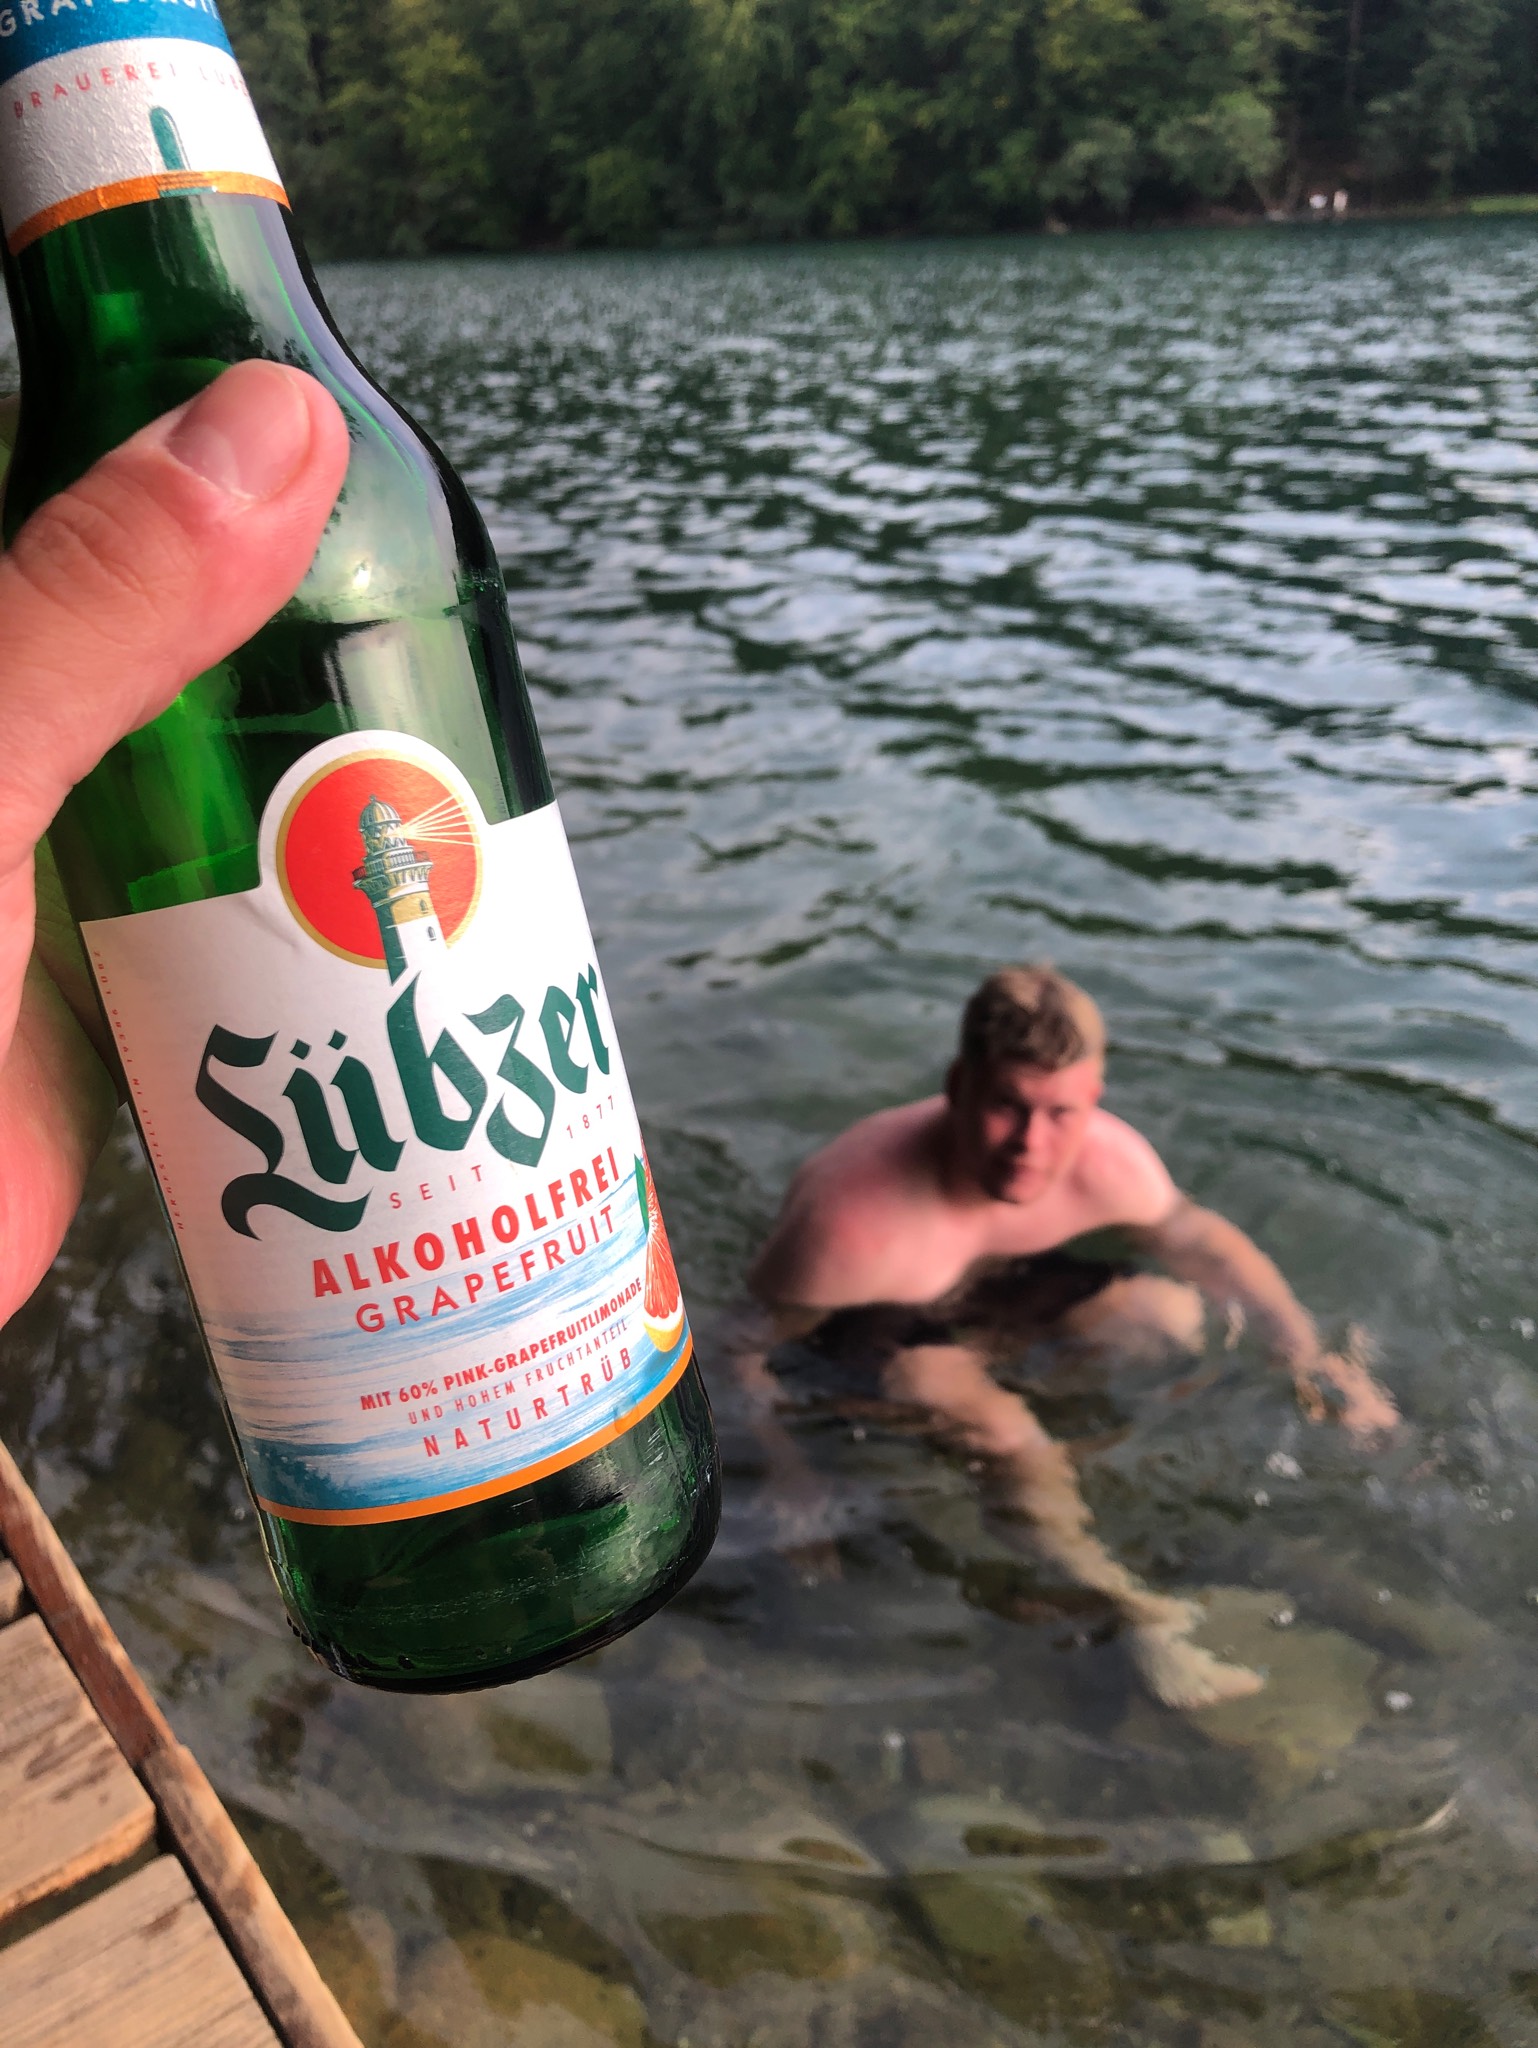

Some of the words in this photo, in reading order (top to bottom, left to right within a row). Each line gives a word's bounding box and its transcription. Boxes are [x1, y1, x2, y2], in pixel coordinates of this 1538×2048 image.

[14, 62, 176, 119] BRAUEREI
[195, 962, 610, 1241] Lübzer
[389, 1164, 484, 1210] SEIT
[566, 1094, 614, 1139] 1877
[313, 1146, 620, 1298] ALKOHOLFREI
[355, 1204, 616, 1333] GRAPEFRUIT
[360, 1393, 393, 1411] MIT
[399, 1380, 439, 1403] 60%
[444, 1277, 643, 1391] PINK-GRAPEFRUITLIMONADE
[408, 1404, 444, 1425] UND
[455, 1381, 517, 1412] HOHEM
[526, 1318, 629, 1387] FRUCHTANTEIL
[423, 1346, 632, 1457] NATURTRÜB
